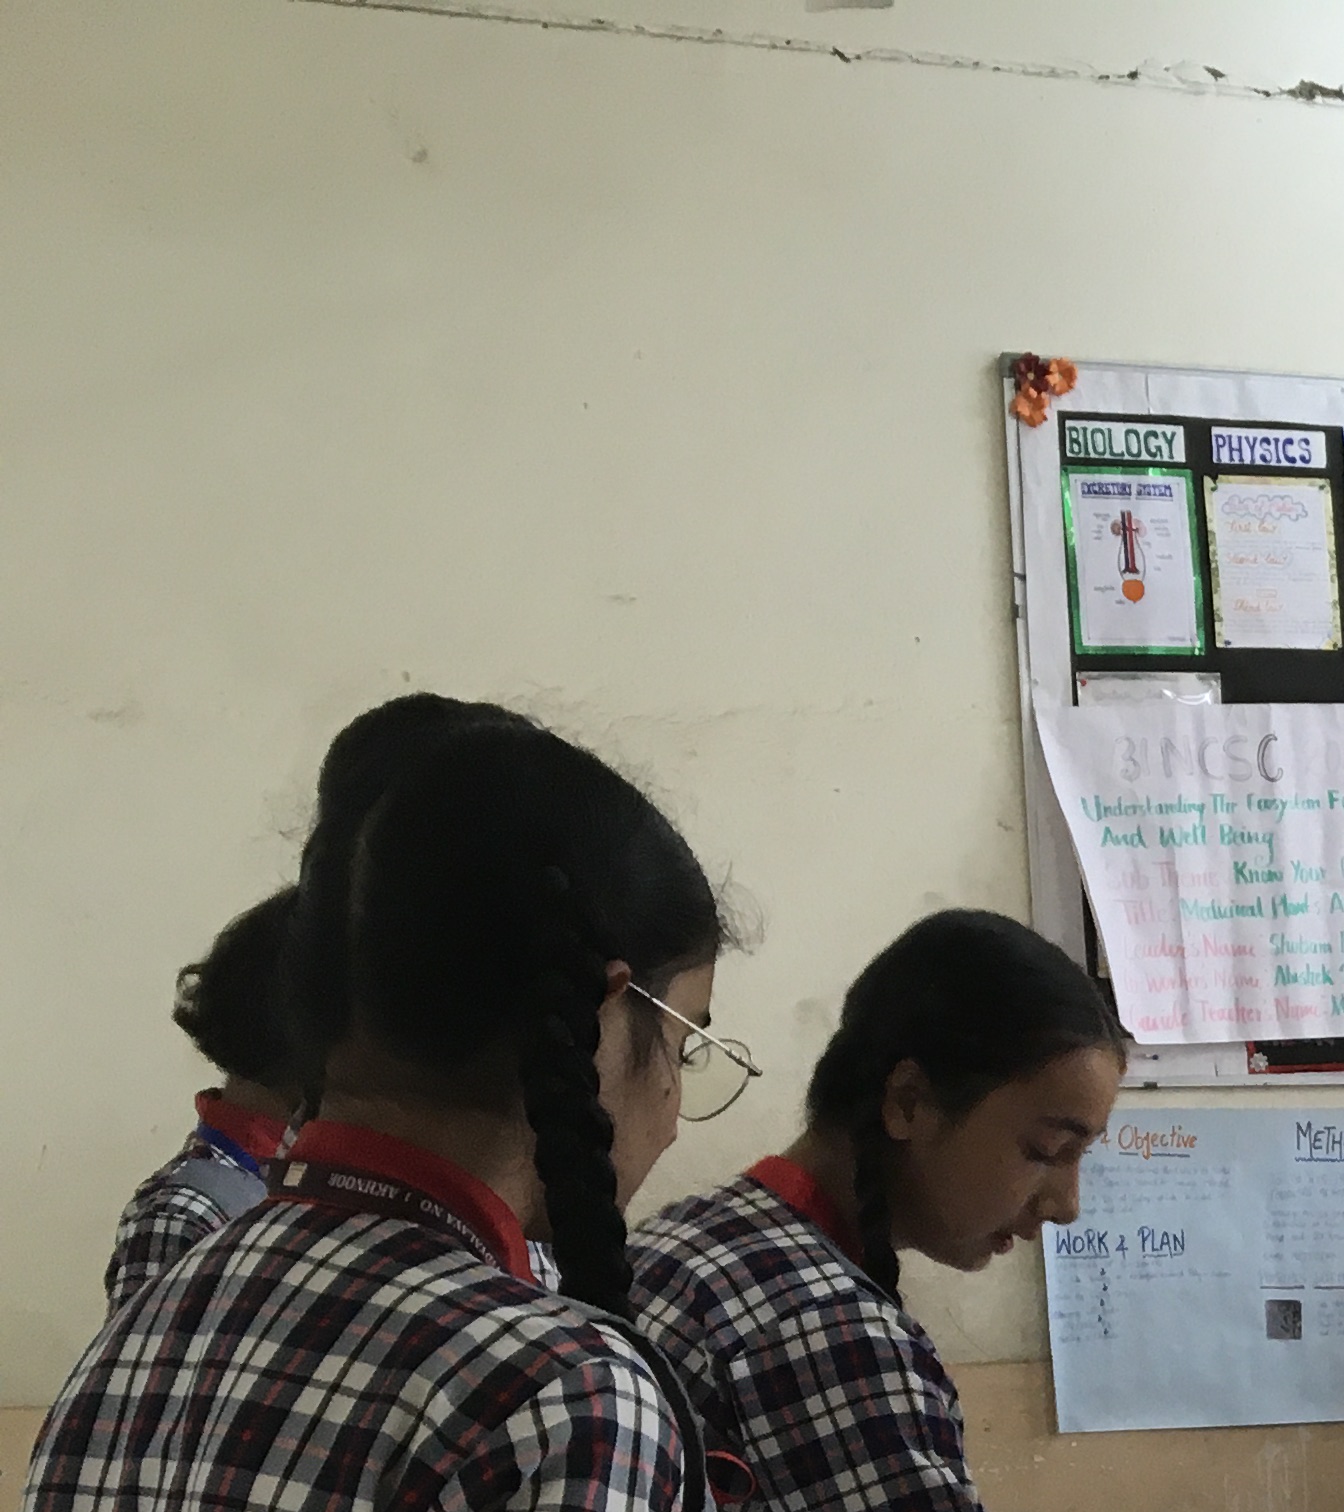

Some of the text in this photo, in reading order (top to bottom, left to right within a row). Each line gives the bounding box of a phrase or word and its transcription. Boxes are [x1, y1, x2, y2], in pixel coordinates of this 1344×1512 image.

[1066, 426, 1177, 460] BIOLOGY
[1213, 433, 1312, 465] PHYSICS
[1100, 825, 1147, 849] And
[1117, 1124, 1198, 1160] Objective
[1055, 1229, 1110, 1255] WORK
[1138, 1225, 1186, 1254] PLAN
